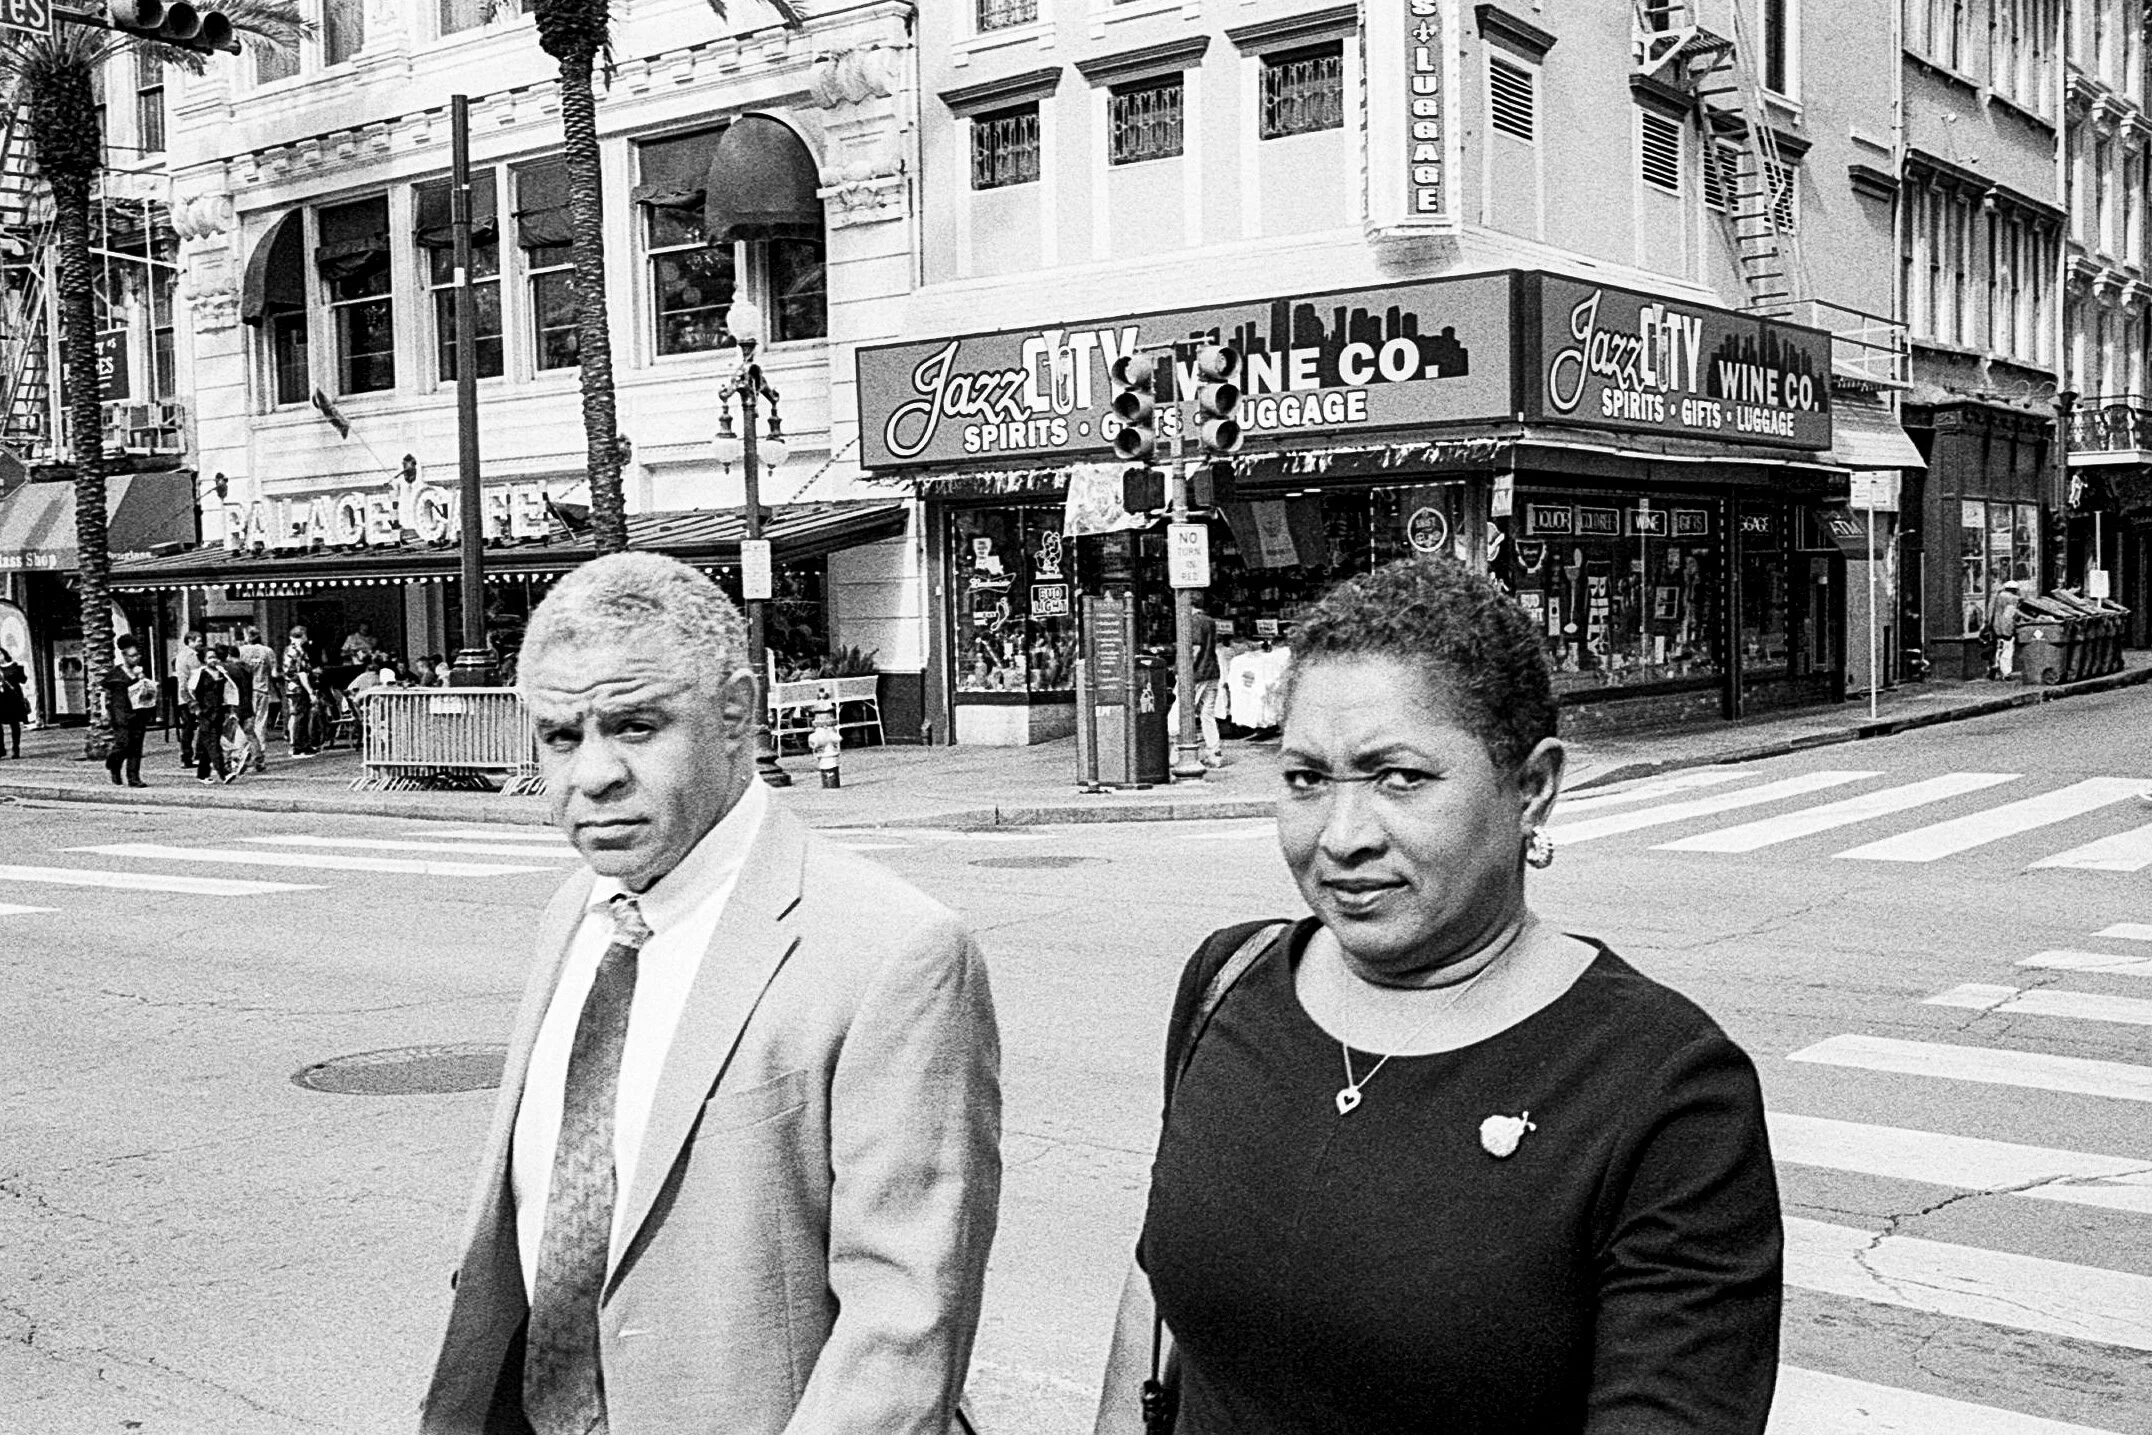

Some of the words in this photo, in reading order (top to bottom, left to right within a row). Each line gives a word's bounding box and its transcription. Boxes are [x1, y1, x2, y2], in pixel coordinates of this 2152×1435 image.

[1411, 46, 1441, 213] LUGGAGE
[1551, 289, 1645, 411] Jazz
[1719, 359, 1779, 406] WINE
[1784, 373, 1820, 412] CO.
[886, 340, 1033, 457] Jazz
[1338, 338, 1440, 386] CO.
[963, 417, 1069, 453] SPIRITS
[1229, 387, 1369, 432] UGGAGE
[1602, 388, 1665, 423] SPIRITS
[1681, 399, 1722, 429] GIFTS
[1736, 405, 1795, 437] LUGGAGE
[223, 492, 398, 553] PALACE
[1179, 532, 1198, 544] NO
[26, 552, 57, 570] Shop
[1038, 587, 1063, 600] BUD
